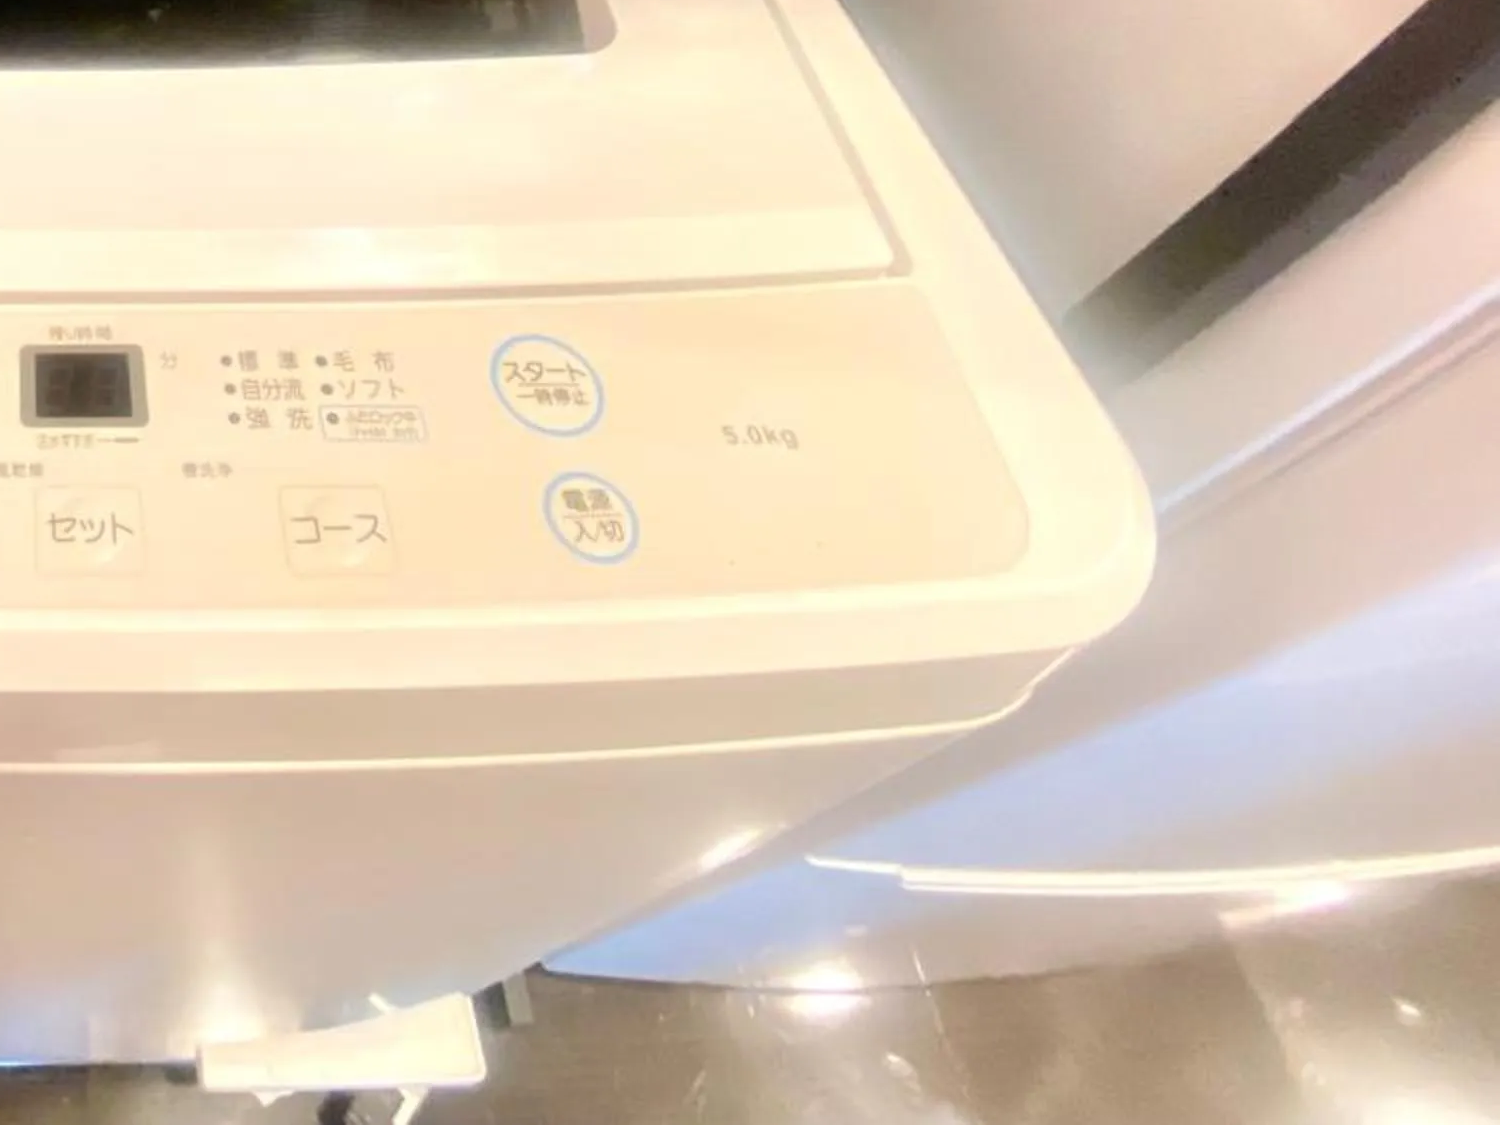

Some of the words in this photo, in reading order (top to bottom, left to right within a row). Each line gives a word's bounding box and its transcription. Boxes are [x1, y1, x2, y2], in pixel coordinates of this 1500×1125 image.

[159, 351, 179, 371] 分
[238, 350, 300, 372] 標準
[333, 350, 396, 373] 毛布
[503, 360, 587, 384] スタート
[240, 377, 307, 402] 自分流
[337, 380, 406, 400] ソフト
[516, 387, 590, 407] 一時停止
[720, 425, 800, 450] 5.0kg
[561, 488, 614, 513] 電源
[47, 512, 134, 544] セット
[291, 513, 389, 545] コース
